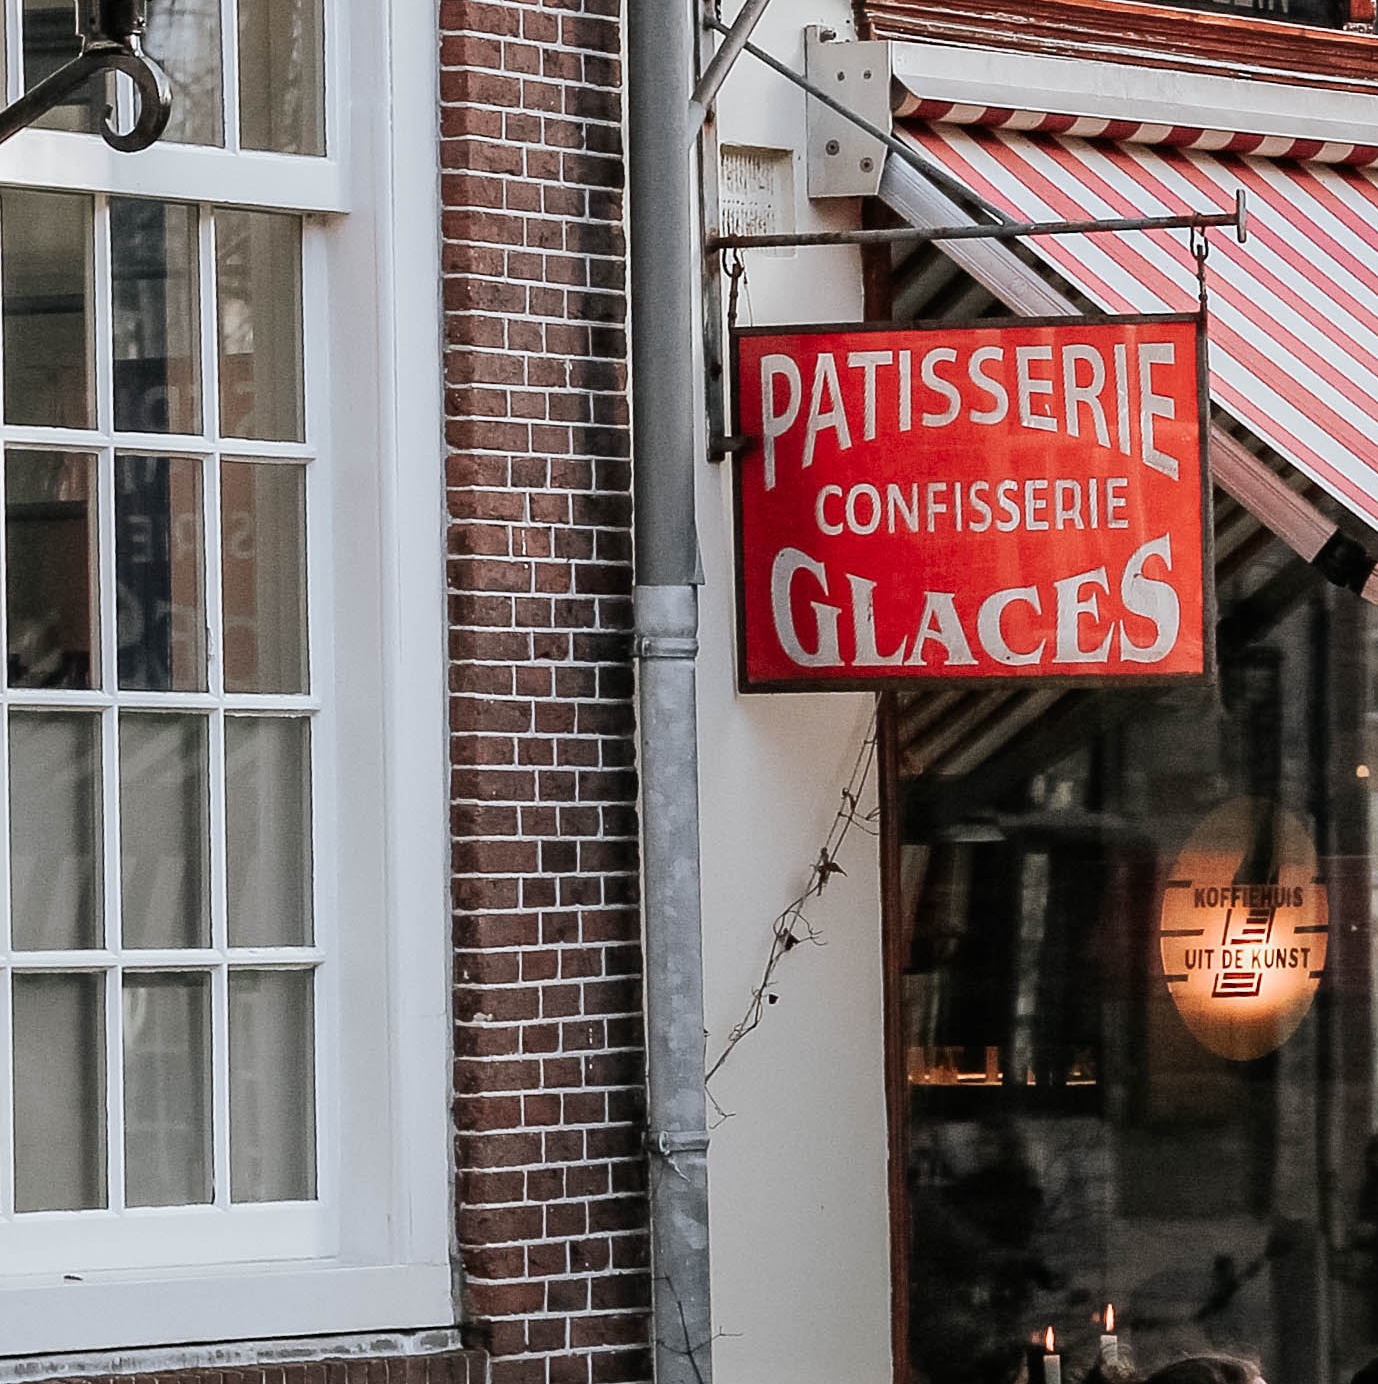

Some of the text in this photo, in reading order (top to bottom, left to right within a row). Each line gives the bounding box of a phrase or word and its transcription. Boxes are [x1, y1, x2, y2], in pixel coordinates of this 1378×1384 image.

[760, 342, 1180, 492] PATISSERIE
[815, 477, 1130, 535] CONFISSERIE
[770, 532, 1181, 669] GLACES
[1194, 886, 1304, 908] KOFFIEHUIS
[1185, 947, 1312, 969] UIT DE KUNST
